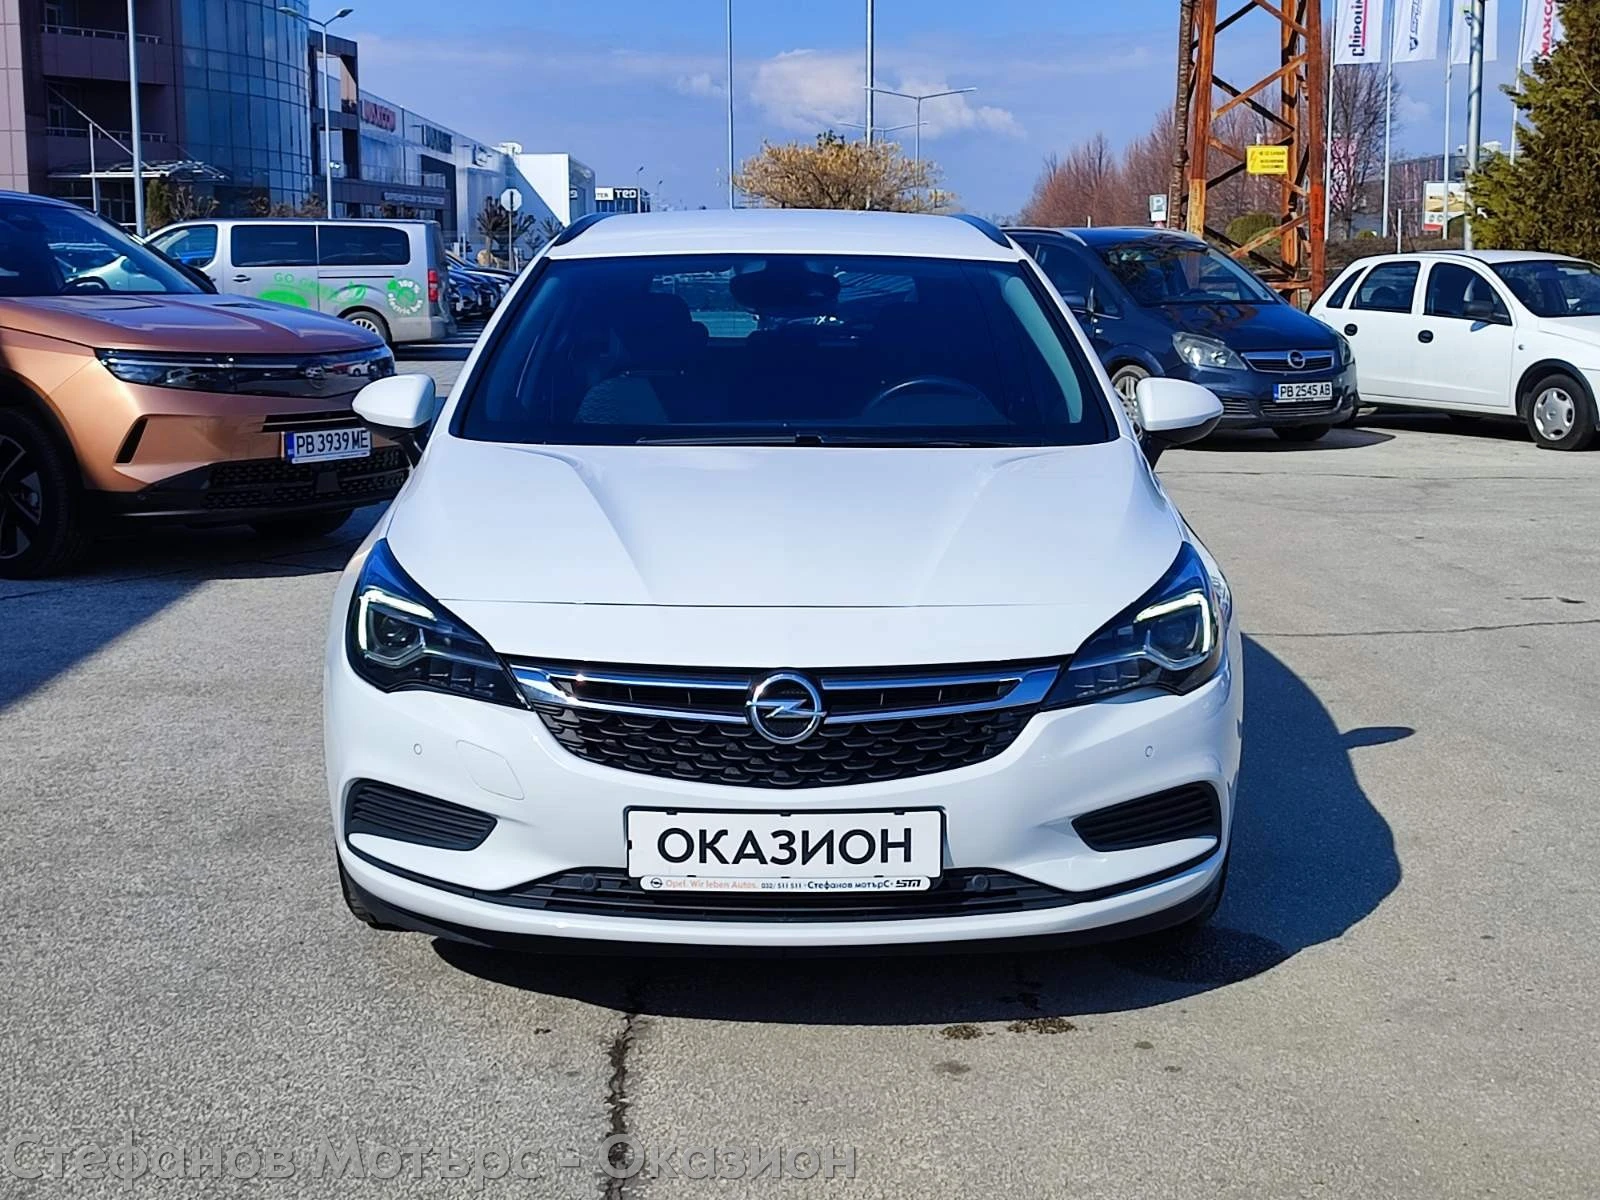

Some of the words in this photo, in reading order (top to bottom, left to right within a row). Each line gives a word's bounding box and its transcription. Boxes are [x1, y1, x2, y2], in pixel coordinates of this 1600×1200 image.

[1296, 384, 1318, 396] 2545
[317, 431, 350, 452] 3939
[657, 827, 912, 865] ОКАЗИОН
